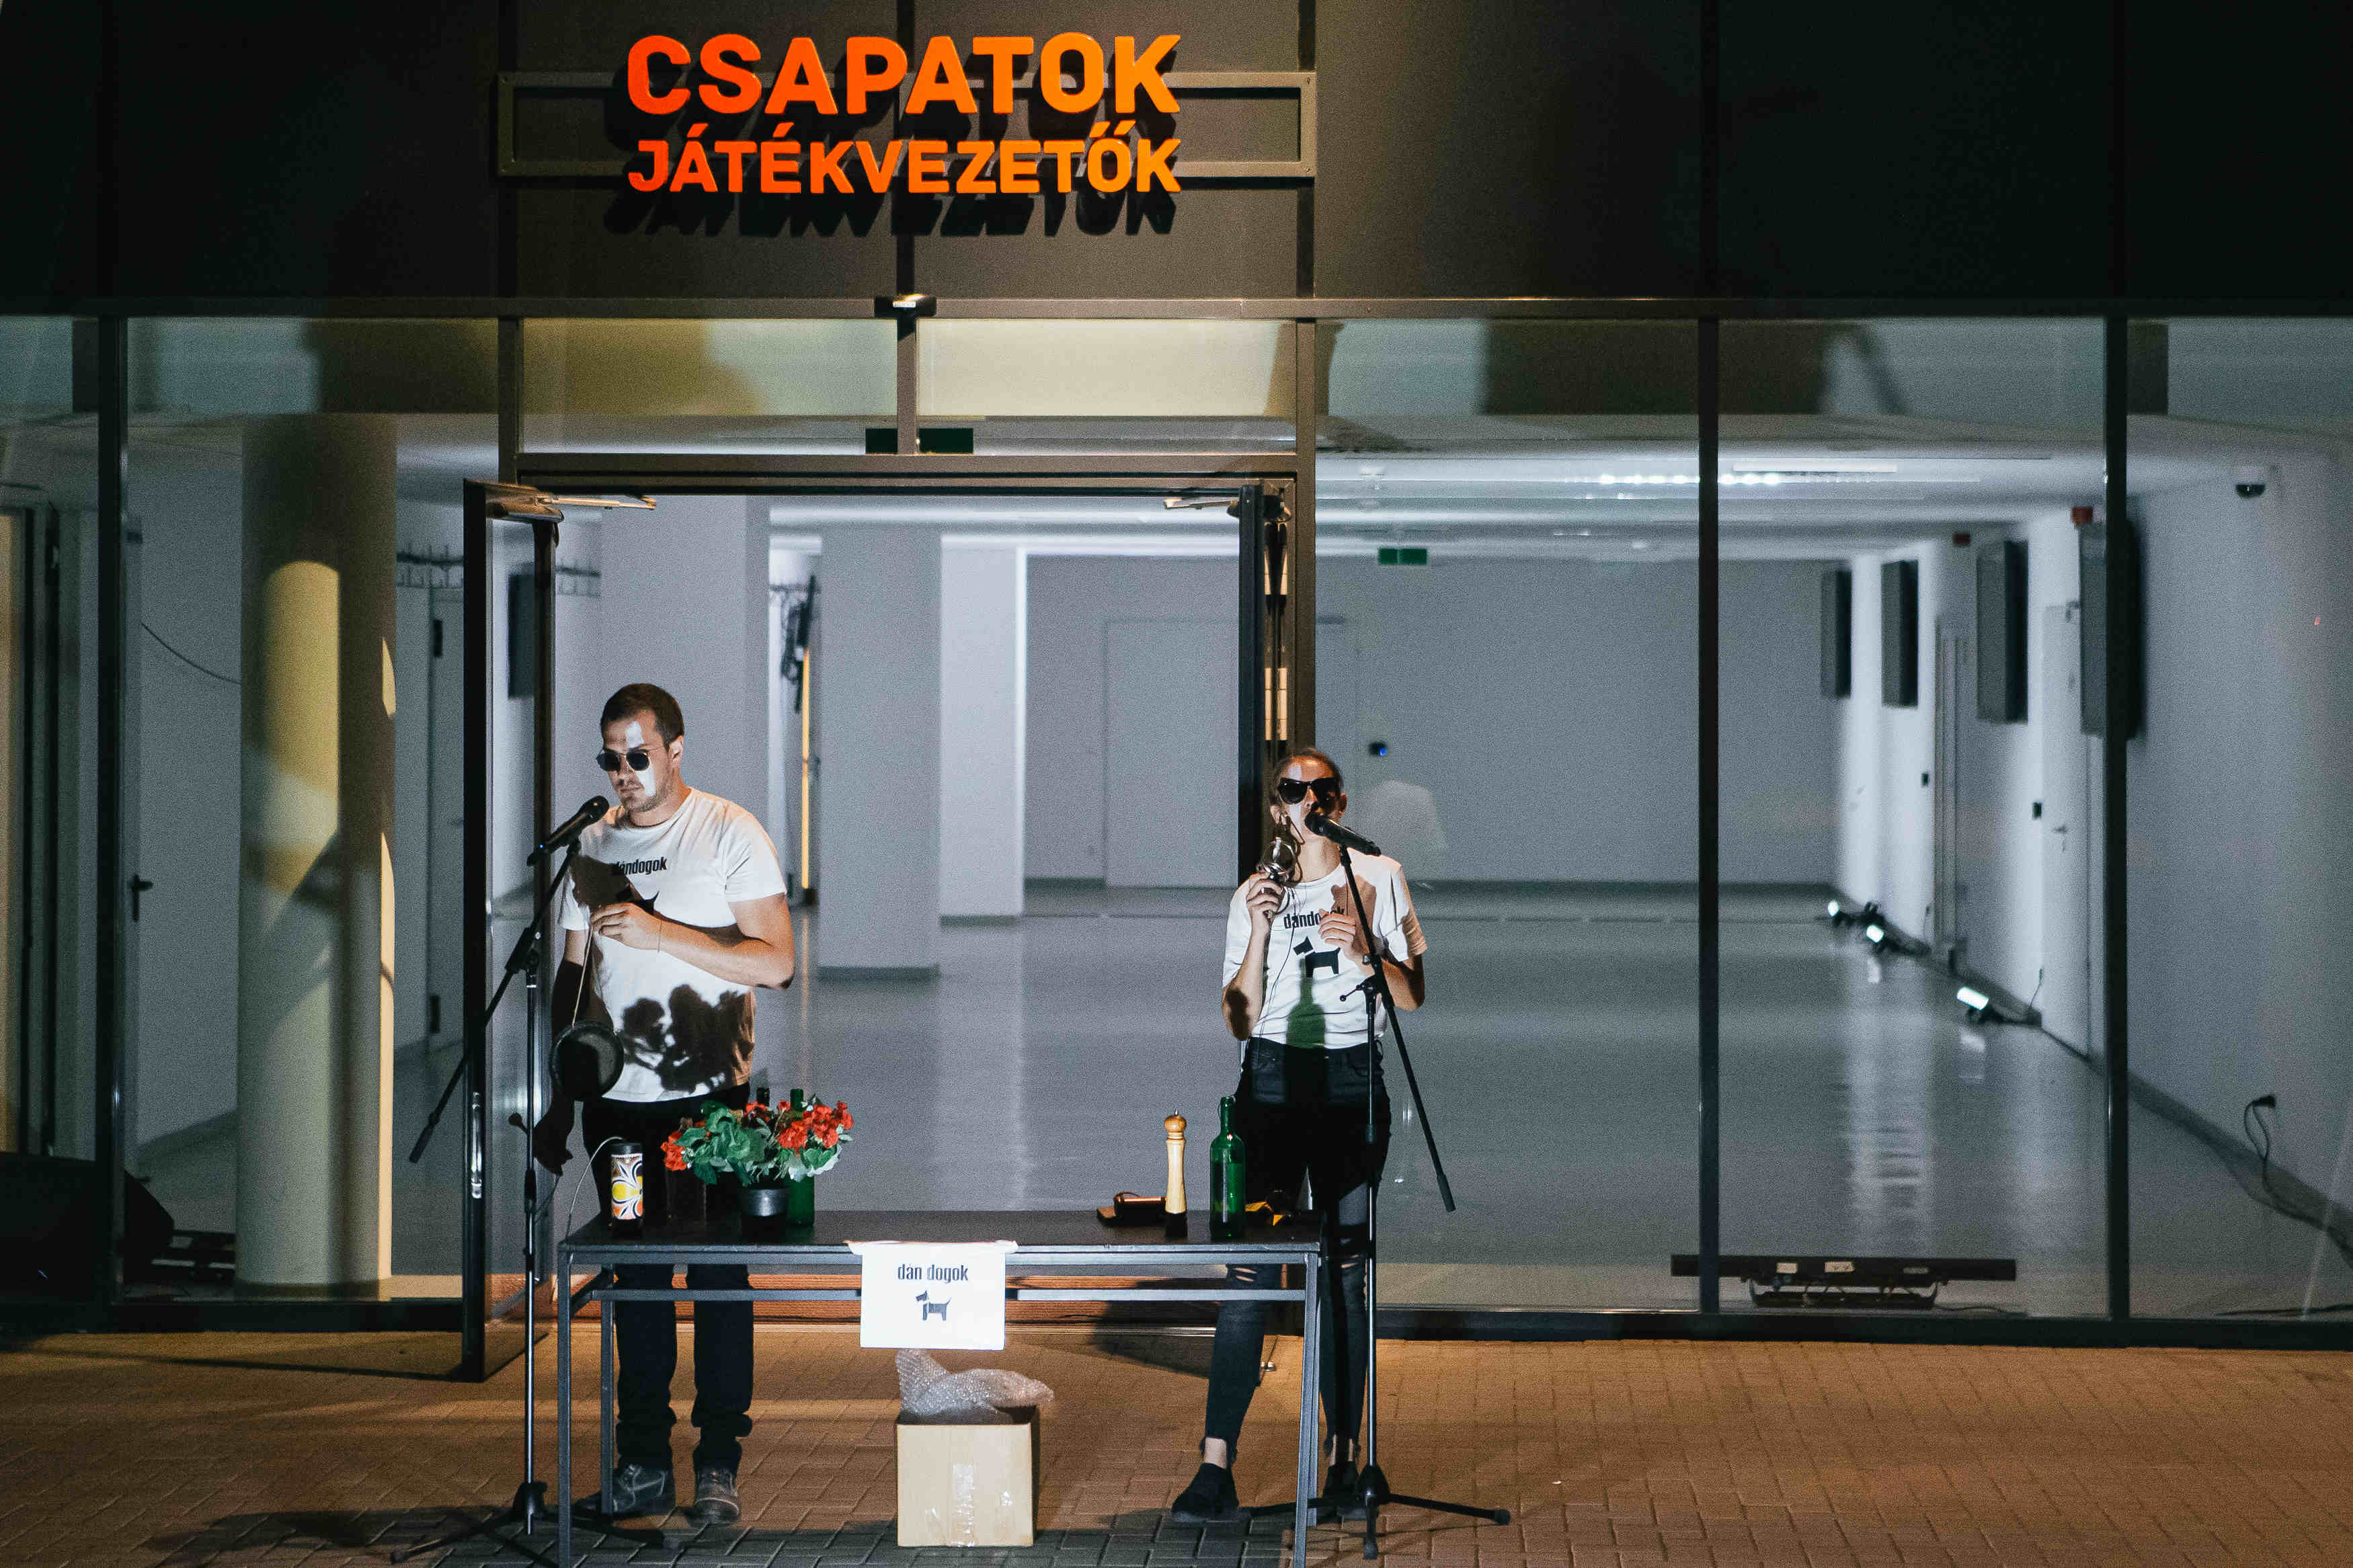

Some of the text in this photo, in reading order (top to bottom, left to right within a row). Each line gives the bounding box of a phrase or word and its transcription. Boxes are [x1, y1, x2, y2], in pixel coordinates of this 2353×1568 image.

[627, 32, 1181, 115] CSAPATOK
[628, 120, 1181, 194] JÁTÉKVEZETŐK
[926, 1264, 969, 1284] dogok
